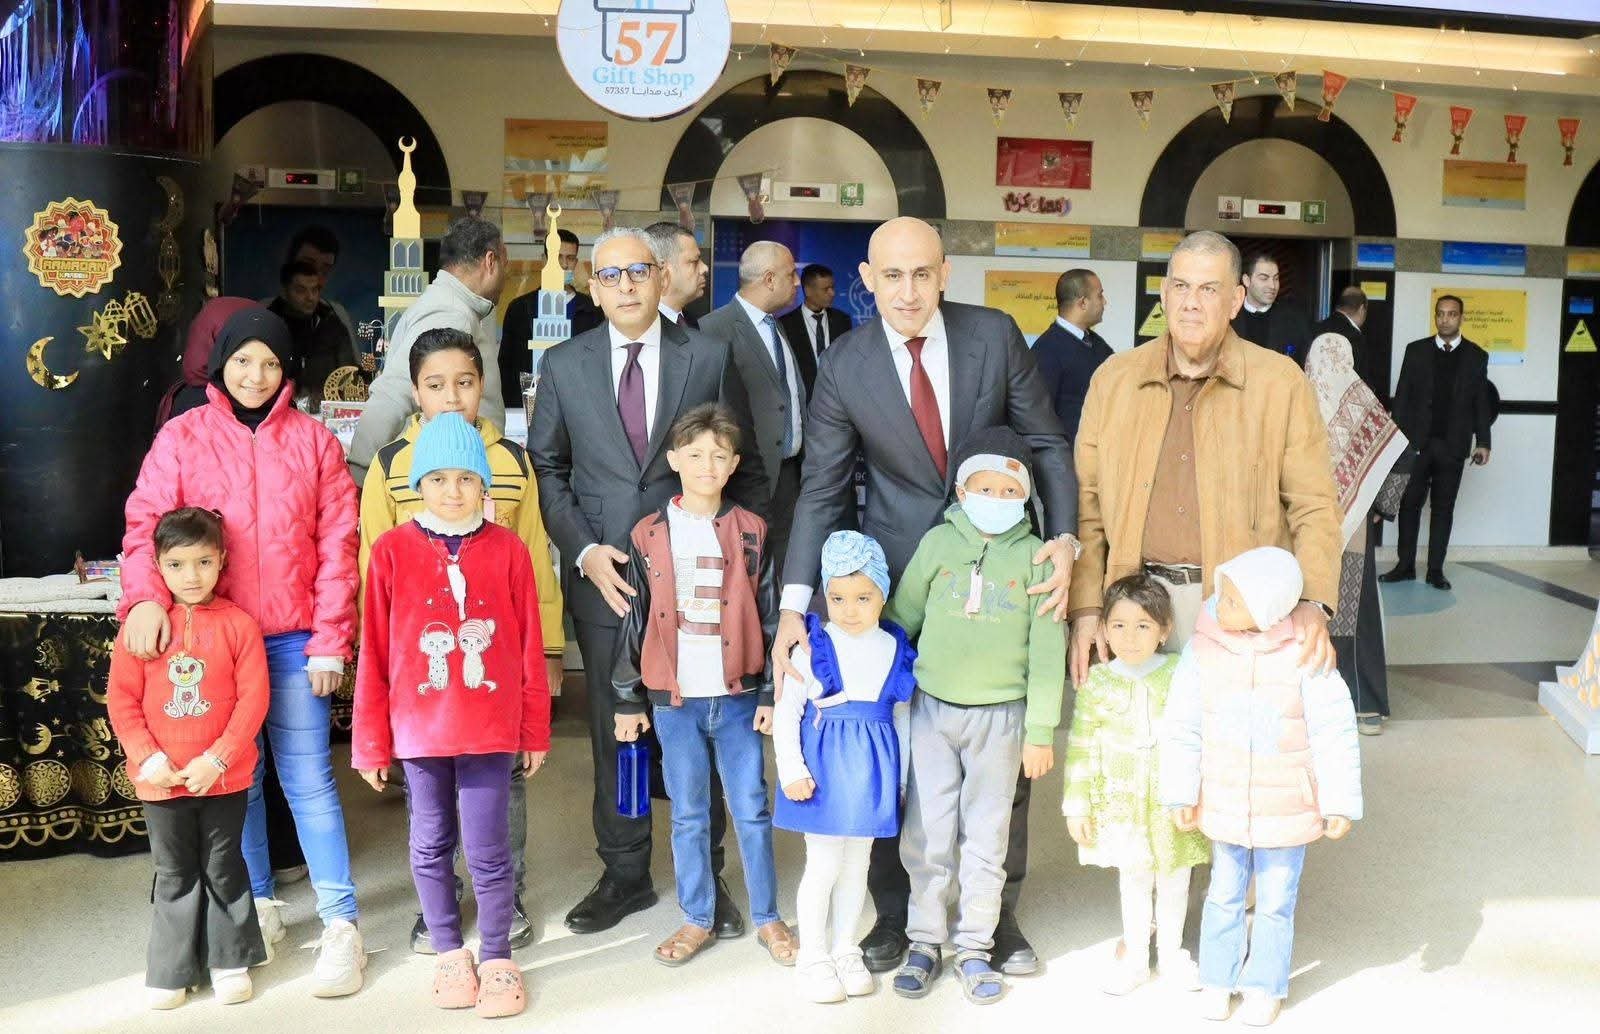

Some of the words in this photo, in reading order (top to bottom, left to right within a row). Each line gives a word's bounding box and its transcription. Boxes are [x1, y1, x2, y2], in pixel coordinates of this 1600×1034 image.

[613, 21, 678, 66] 57
[592, 66, 636, 85] Gift
[643, 67, 695, 90] Shop
[604, 86, 630, 95] 57357
[663, 87, 683, 97] ركن
[42, 260, 107, 272] RAMADAN
